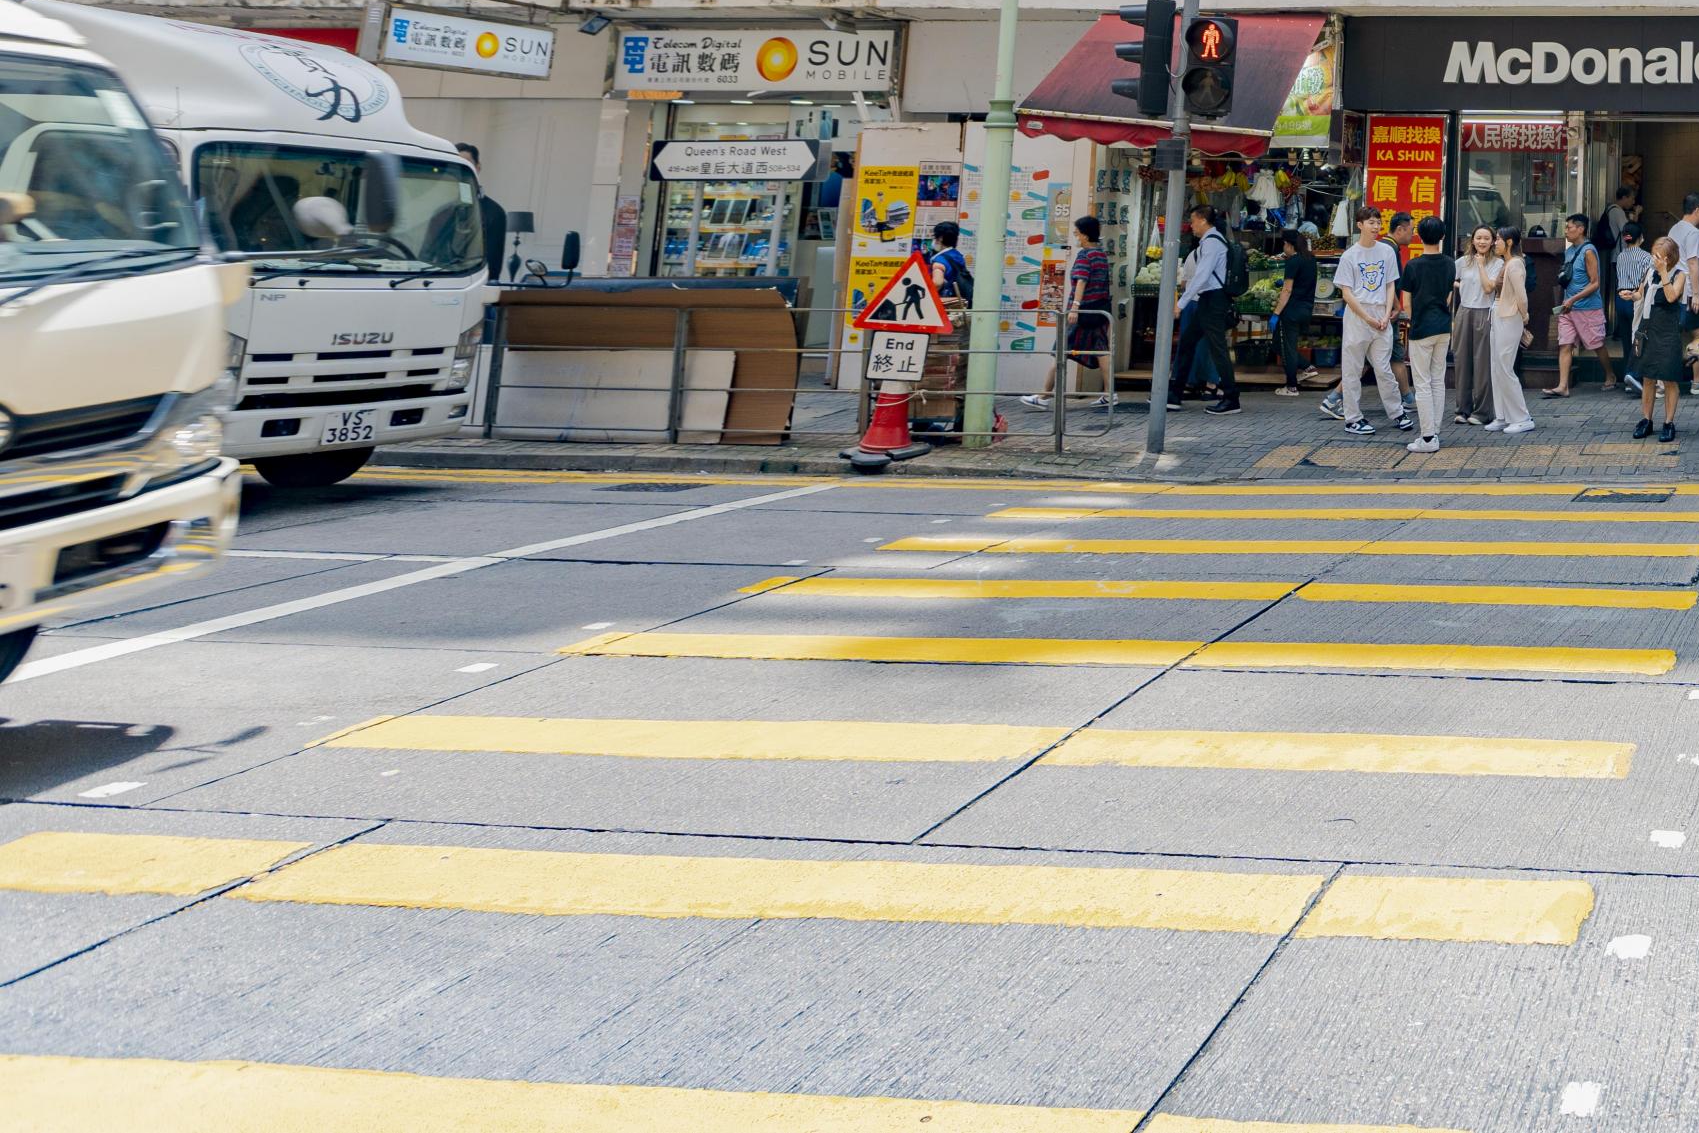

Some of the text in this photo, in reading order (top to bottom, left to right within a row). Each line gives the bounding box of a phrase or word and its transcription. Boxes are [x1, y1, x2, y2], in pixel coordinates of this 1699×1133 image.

[504, 37, 549, 57] SUN
[652, 37, 742, 51] Telecom Digital
[808, 40, 888, 67] SUN
[650, 52, 741, 74] 電訊數碼
[717, 75, 738, 84] 6033
[806, 70, 886, 81] MOBILE
[1372, 125, 1441, 144] 嘉順找換
[685, 146, 787, 157] Queen's Road West
[1376, 150, 1435, 161] KA SHUN
[700, 162, 769, 175] 皇后大道西
[260, 294, 286, 302] NP
[331, 332, 394, 346] ISUZU
[886, 338, 915, 351] End
[872, 353, 919, 373] 終止
[342, 411, 364, 427] VS
[326, 425, 373, 443] 3852
